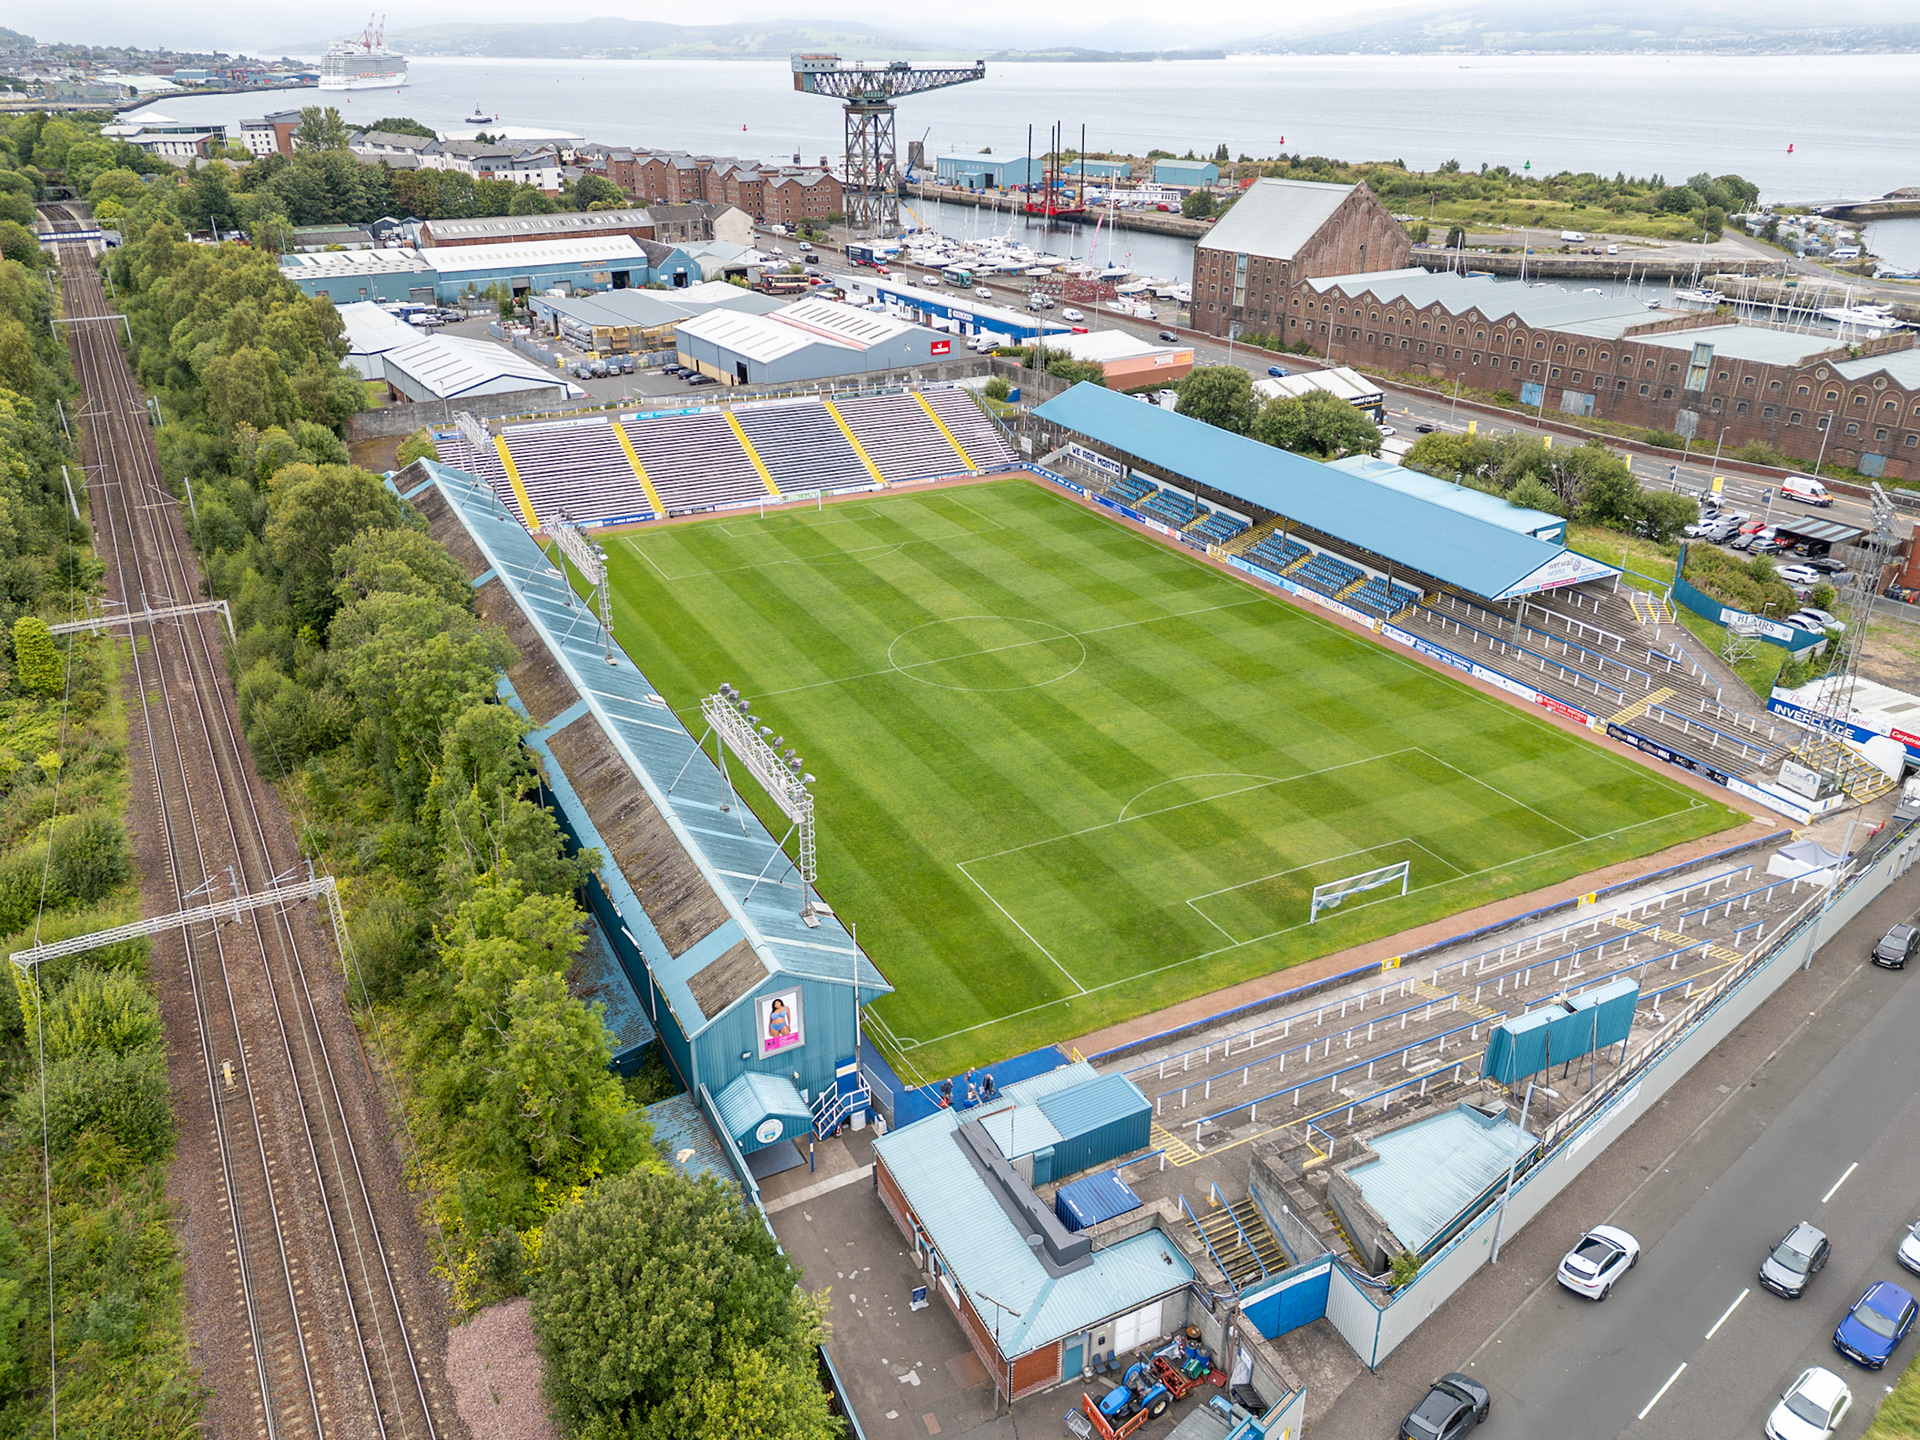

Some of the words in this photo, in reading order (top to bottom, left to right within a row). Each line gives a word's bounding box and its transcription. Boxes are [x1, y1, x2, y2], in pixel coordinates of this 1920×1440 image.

[1072, 446, 1081, 456] WE
[1082, 450, 1096, 463] ARE
[1097, 457, 1123, 474] MORTO
[1301, 588, 1321, 601] CLYDE
[1322, 597, 1344, 612] INJURY
[1345, 607, 1369, 624] CLINIC
[1737, 615, 1776, 632] BLAIRS
